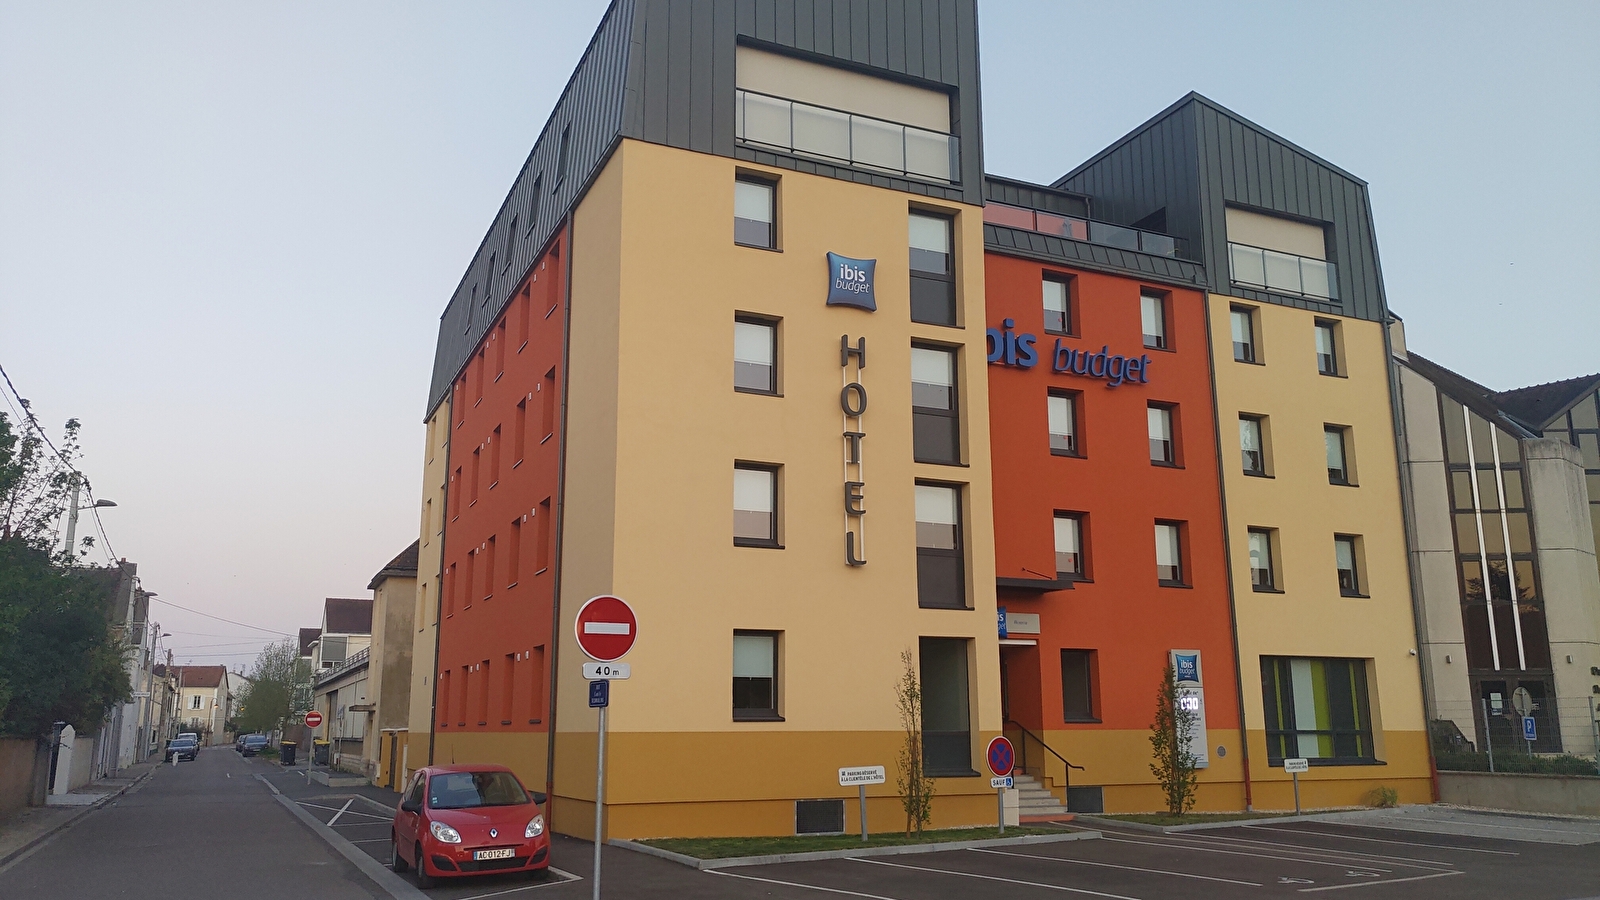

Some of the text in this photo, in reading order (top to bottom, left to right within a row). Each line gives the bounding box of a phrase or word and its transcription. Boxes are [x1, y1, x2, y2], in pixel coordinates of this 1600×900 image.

[840, 263, 866, 282] ibis
[835, 277, 871, 294] budget
[1052, 338, 1152, 387] budget
[840, 334, 868, 567] HOTEL
[595, 666, 611, 676] 40
[1180, 659, 1193, 669] ibis
[992, 779, 1005, 787] SAUF
